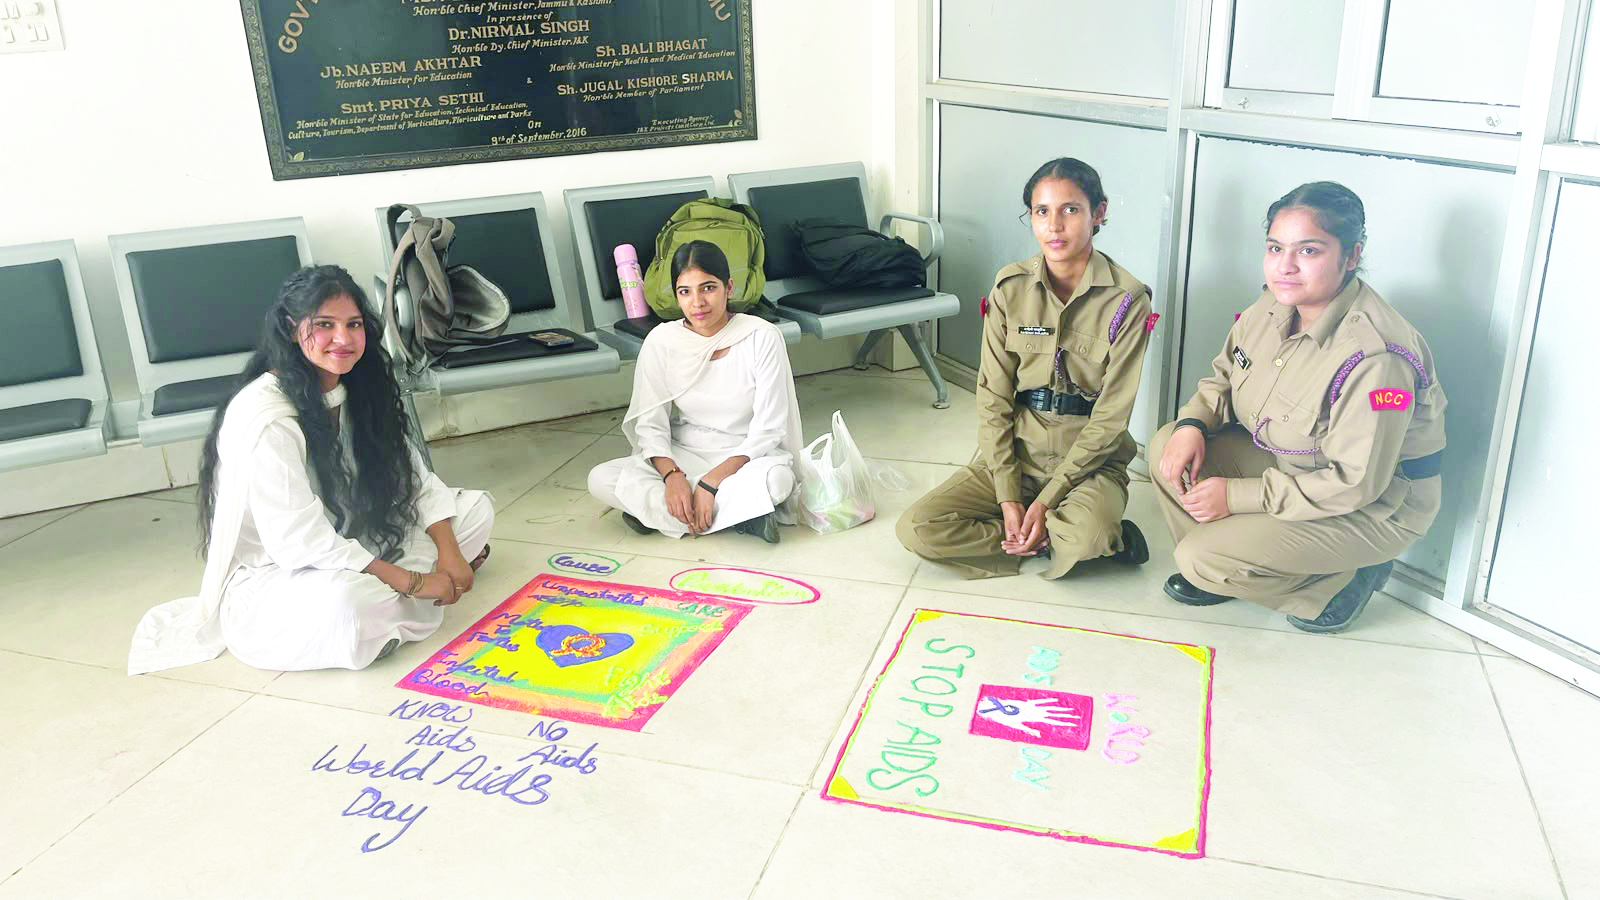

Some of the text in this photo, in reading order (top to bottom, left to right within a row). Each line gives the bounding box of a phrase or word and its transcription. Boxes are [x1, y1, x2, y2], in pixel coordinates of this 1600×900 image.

[457, 3, 487, 15] Chief
[487, 11, 554, 24] In presence of
[540, 20, 590, 34] SINGH
[507, 40, 531, 51] Chief
[656, 38, 708, 53] BHAGAT
[413, 55, 483, 72] AKHTAR
[624, 55, 649, 66] Health
[649, 54, 665, 64] and
[666, 52, 696, 62] Medical
[697, 49, 736, 60] Education
[371, 76, 412, 87] Minister
[413, 74, 428, 85] for
[430, 71, 473, 82] Education
[627, 75, 678, 90] KISHORE
[682, 70, 735, 85] SHARMA
[438, 92, 485, 106] SETHI
[616, 90, 647, 99] Member
[648, 88, 658, 98] of
[659, 84, 705, 95] Parliament
[329, 117, 367, 127] Minister
[367, 114, 378, 124] of
[378, 113, 400, 122] State
[400, 111, 414, 121] for
[455, 105, 490, 115] Technical
[510, 110, 533, 119] Parks
[528, 120, 542, 129] On
[506, 134, 517, 145] of
[566, 128, 588, 139] 2016
[1375, 391, 1404, 406] NCC
[677, 602, 727, 618] CARE
[412, 669, 489, 696] Blood
[898, 637, 976, 718] STOP
[405, 724, 476, 752] Aids
[516, 742, 599, 775] Aids
[866, 720, 942, 797] AIDS
[311, 743, 552, 806] World Aids
[341, 786, 428, 853] Day
